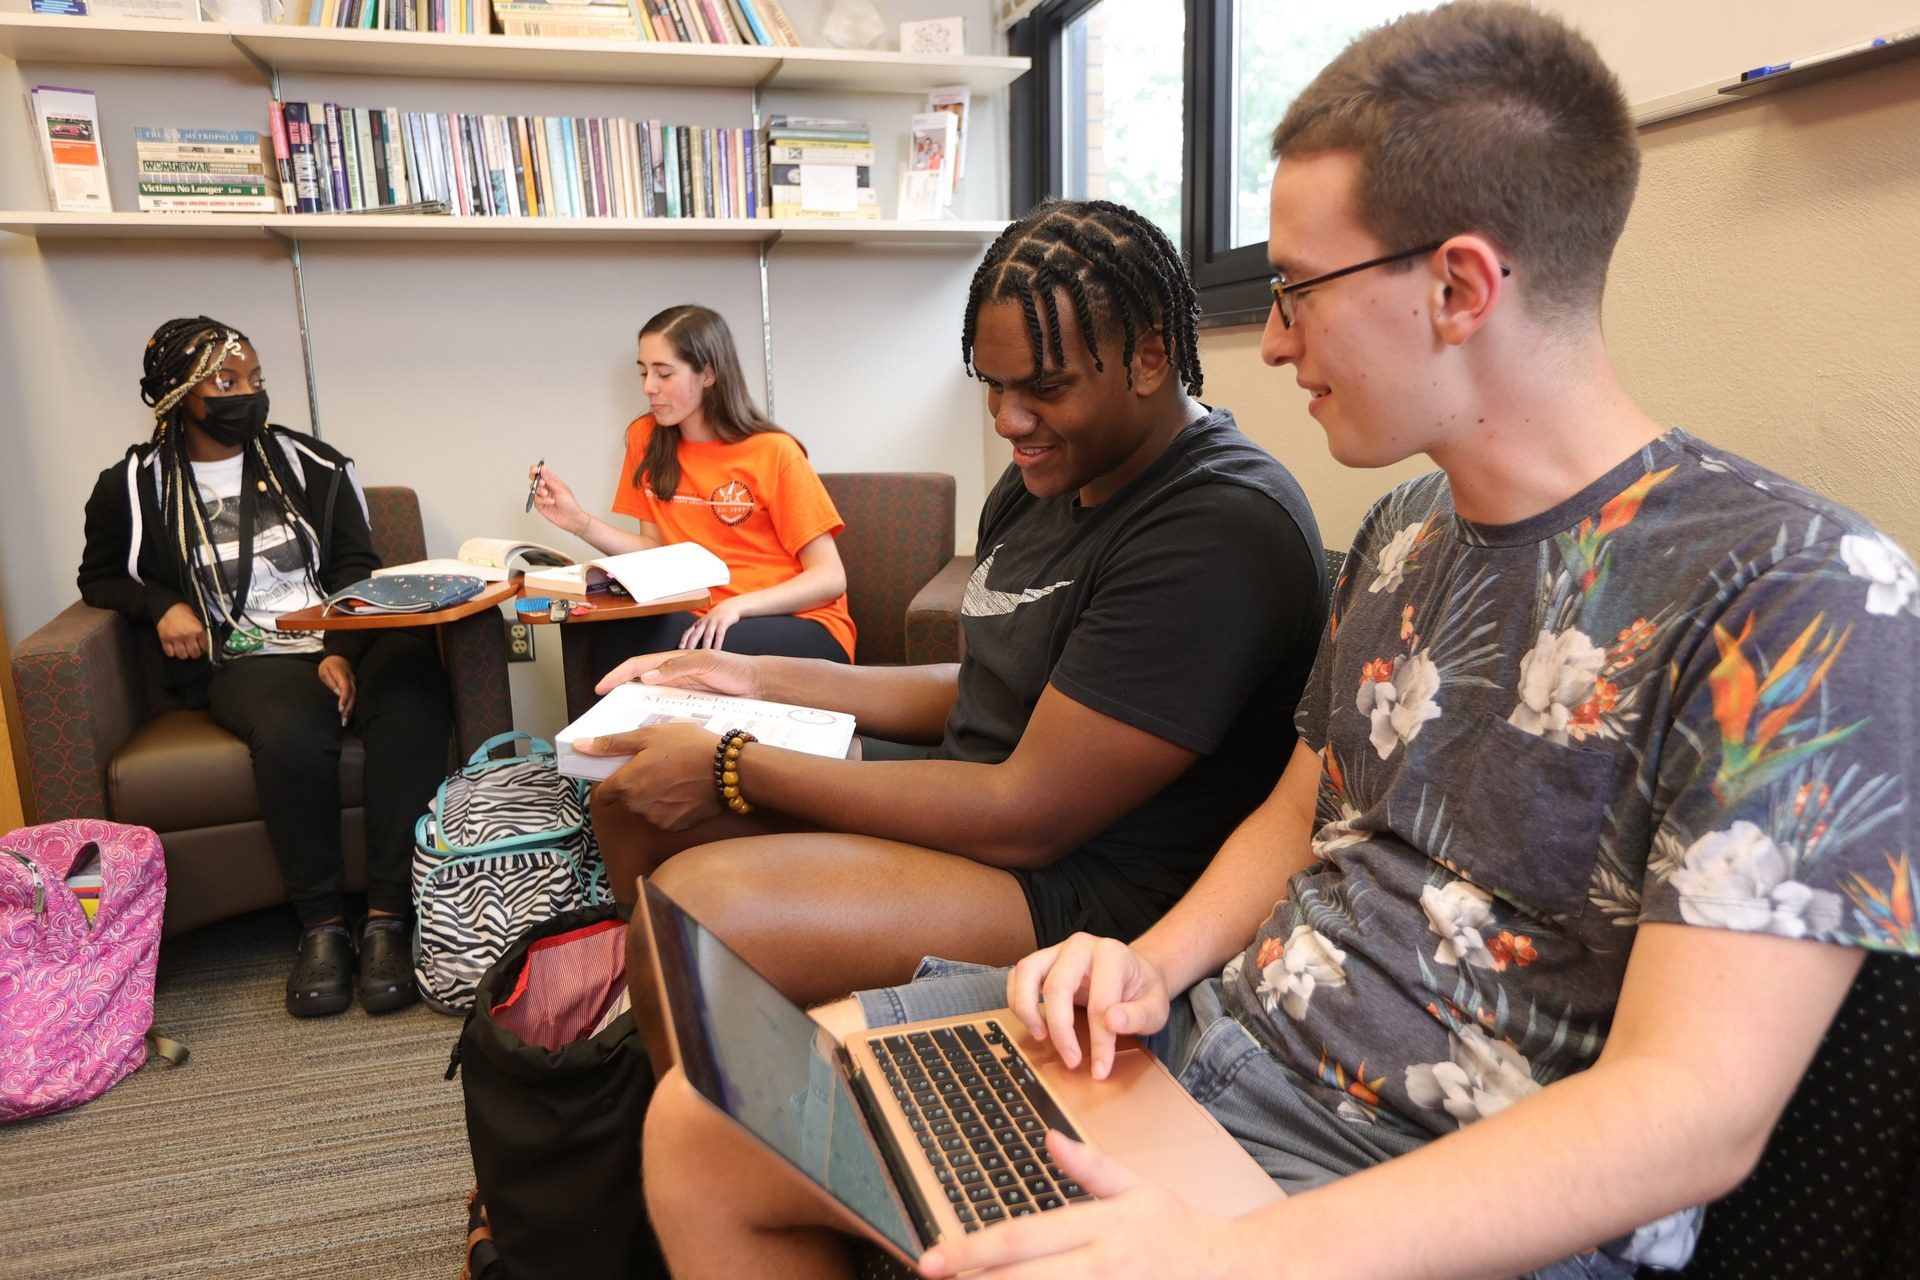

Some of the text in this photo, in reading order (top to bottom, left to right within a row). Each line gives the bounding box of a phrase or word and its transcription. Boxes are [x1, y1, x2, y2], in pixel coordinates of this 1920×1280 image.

[331, 143, 340, 157] THE
[144, 161, 180, 172] WOMEN
[293, 152, 319, 200] BACKLASH
[142, 184, 176, 193] Victims
[177, 185, 191, 193] No
[191, 186, 224, 196] Longer
[723, 495, 741, 504] PLA
